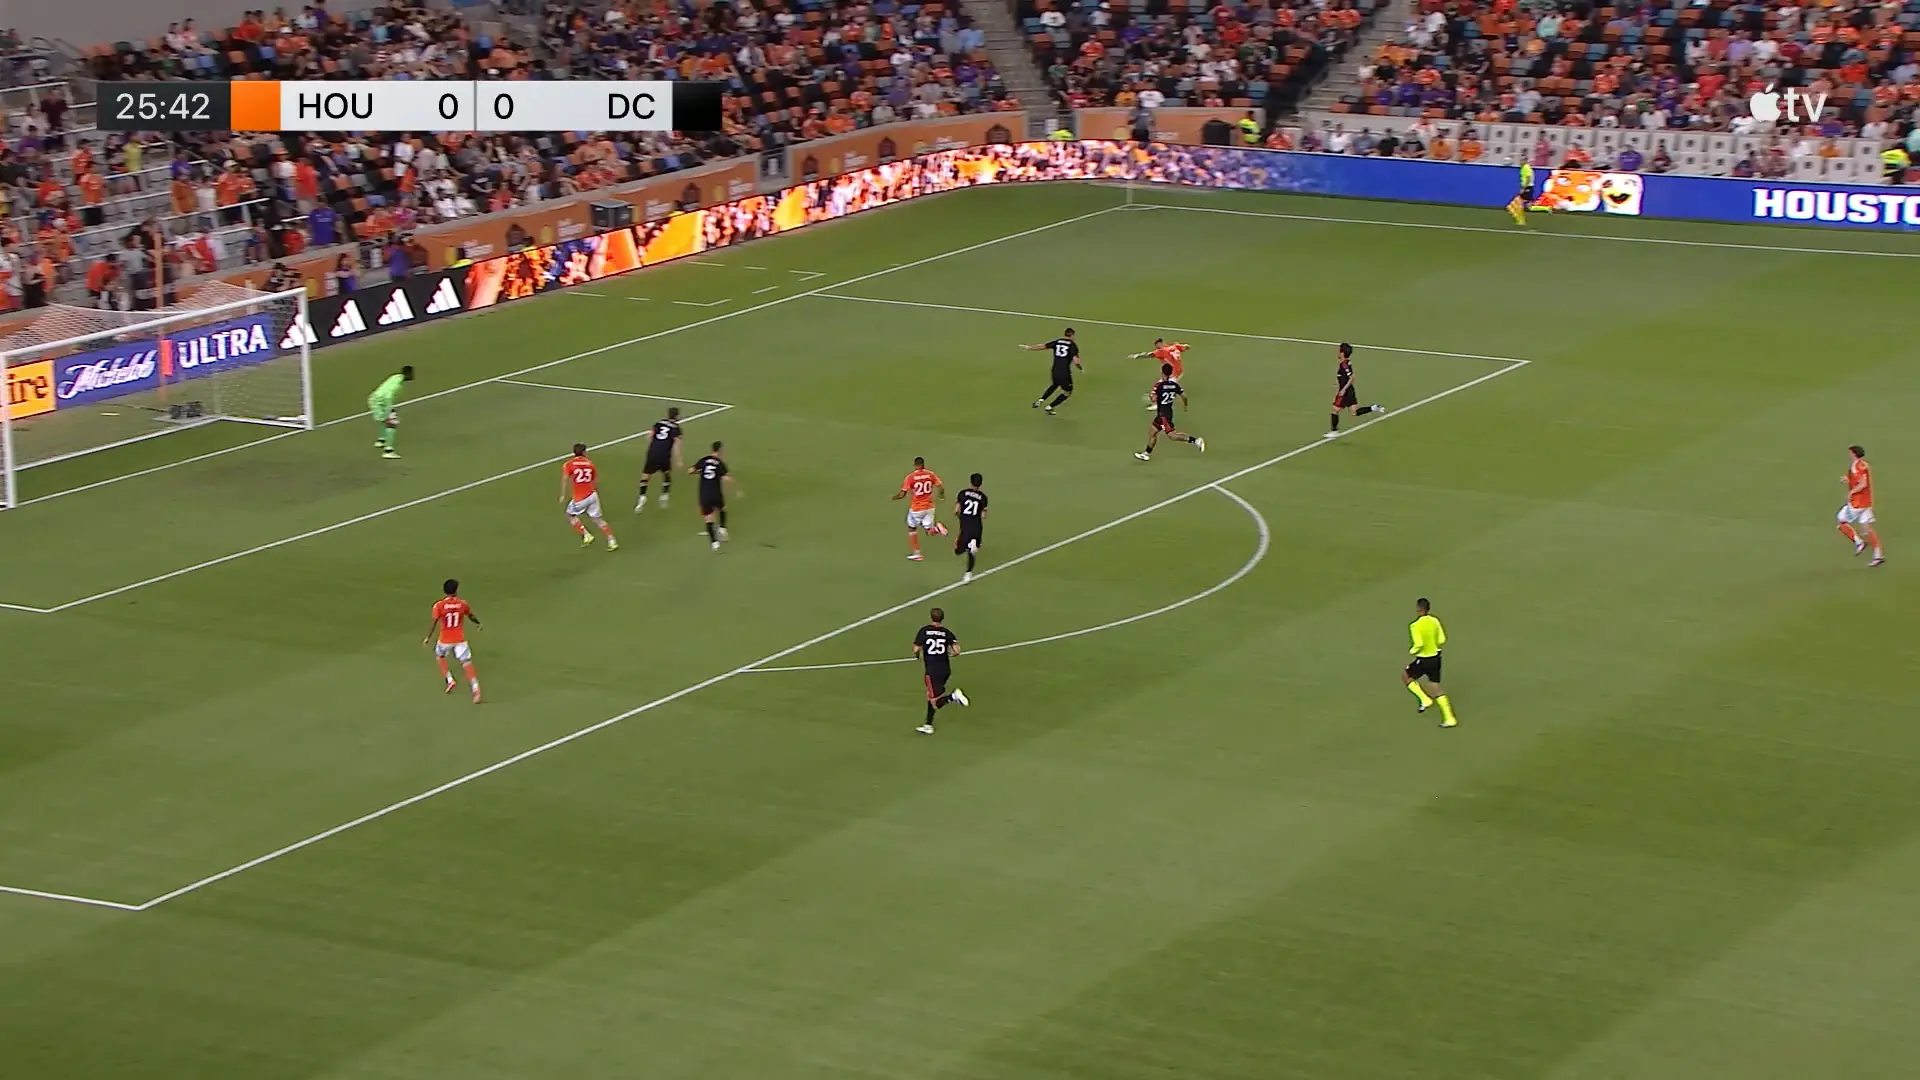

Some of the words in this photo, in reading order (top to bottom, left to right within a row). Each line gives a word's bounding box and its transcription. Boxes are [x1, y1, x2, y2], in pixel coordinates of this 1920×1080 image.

[1753, 188, 1920, 225] HOUSTO
[177, 323, 269, 369] ULTRA
[1055, 344, 1069, 357] 13
[1161, 391, 1176, 405] 23
[656, 426, 670, 440] 3
[573, 468, 592, 483] 23
[703, 464, 716, 479] 5
[913, 480, 932, 496] 20
[963, 499, 979, 516] 21
[445, 611, 460, 628] 11
[925, 638, 947, 655] 25
